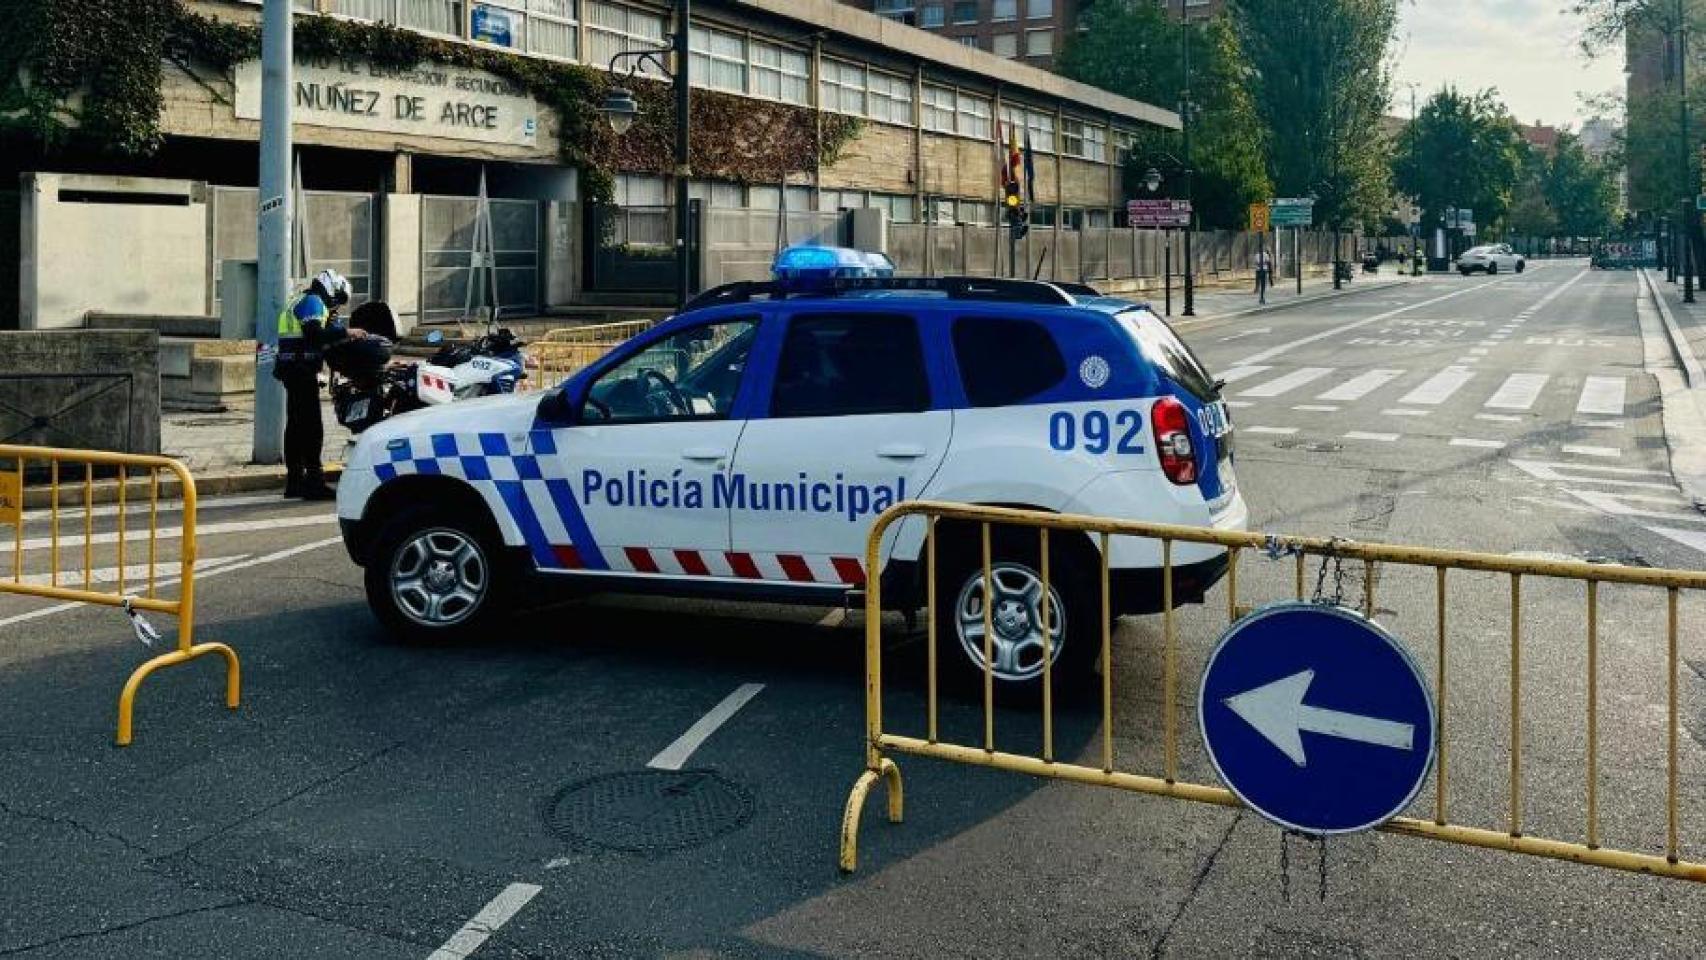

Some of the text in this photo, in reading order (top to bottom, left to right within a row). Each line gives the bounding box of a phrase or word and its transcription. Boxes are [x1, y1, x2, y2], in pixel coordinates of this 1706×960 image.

[395, 94, 426, 120] DE
[441, 101, 498, 129] ARCE
[1050, 410, 1145, 455] 092
[582, 468, 906, 522] Policía Municipal
